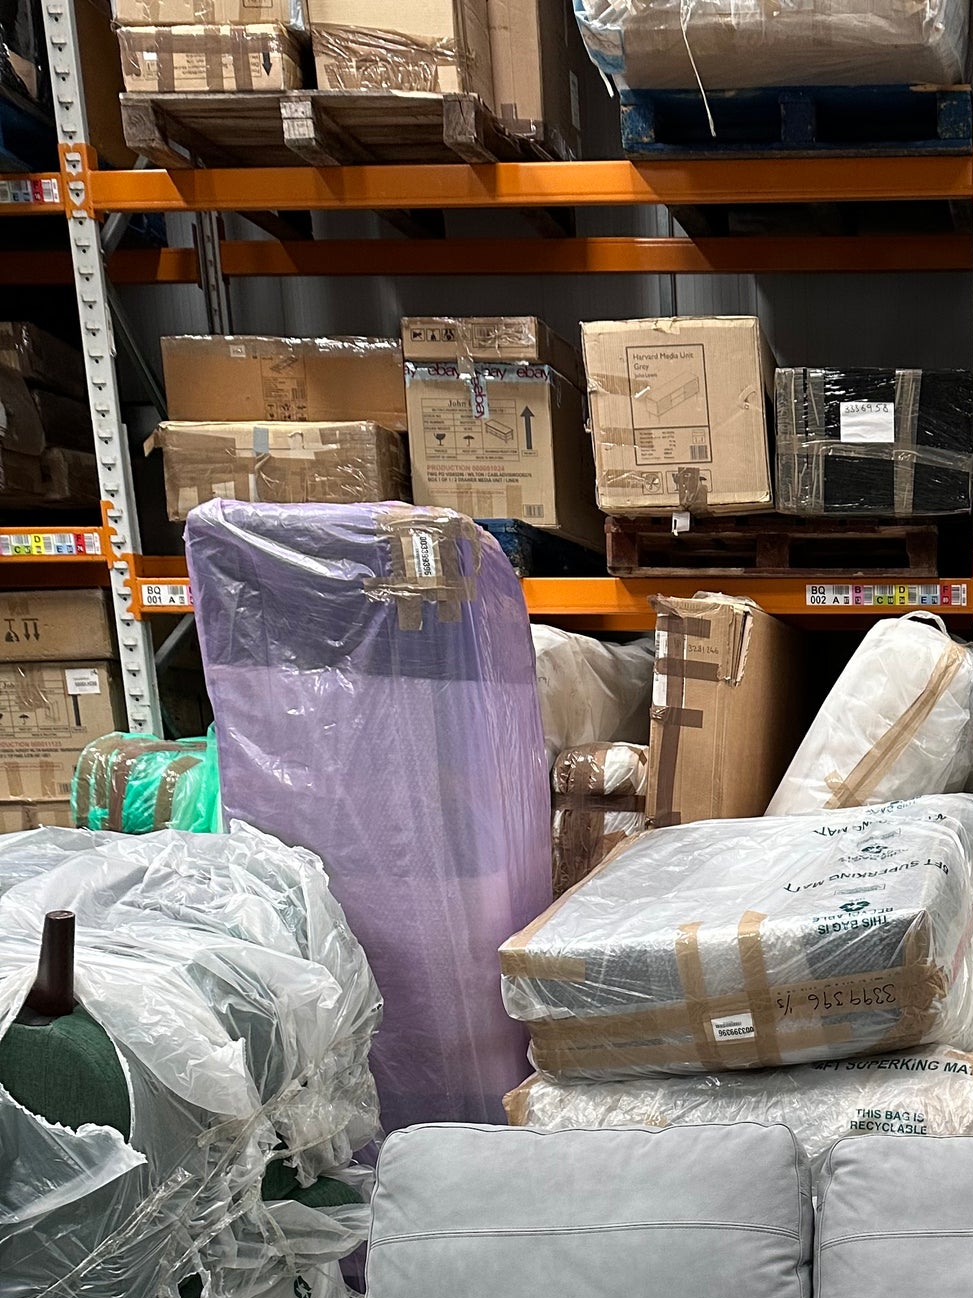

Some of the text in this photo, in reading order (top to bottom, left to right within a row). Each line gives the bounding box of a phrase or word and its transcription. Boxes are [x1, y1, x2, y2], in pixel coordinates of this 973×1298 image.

[517, 364, 549, 380] ebay
[634, 363, 649, 371] Grey
[845, 404, 888, 413] 3336958
[148, 586, 161, 595] BQ
[811, 586, 825, 595] BQ
[811, 596, 826, 604] 002
[818, 915, 888, 935] THIS BAG IS
[846, 1059, 939, 1071] SUPERKING
[856, 1109, 924, 1122] THIS BAG IS
[850, 1121, 926, 1134] RECYCLABLE
